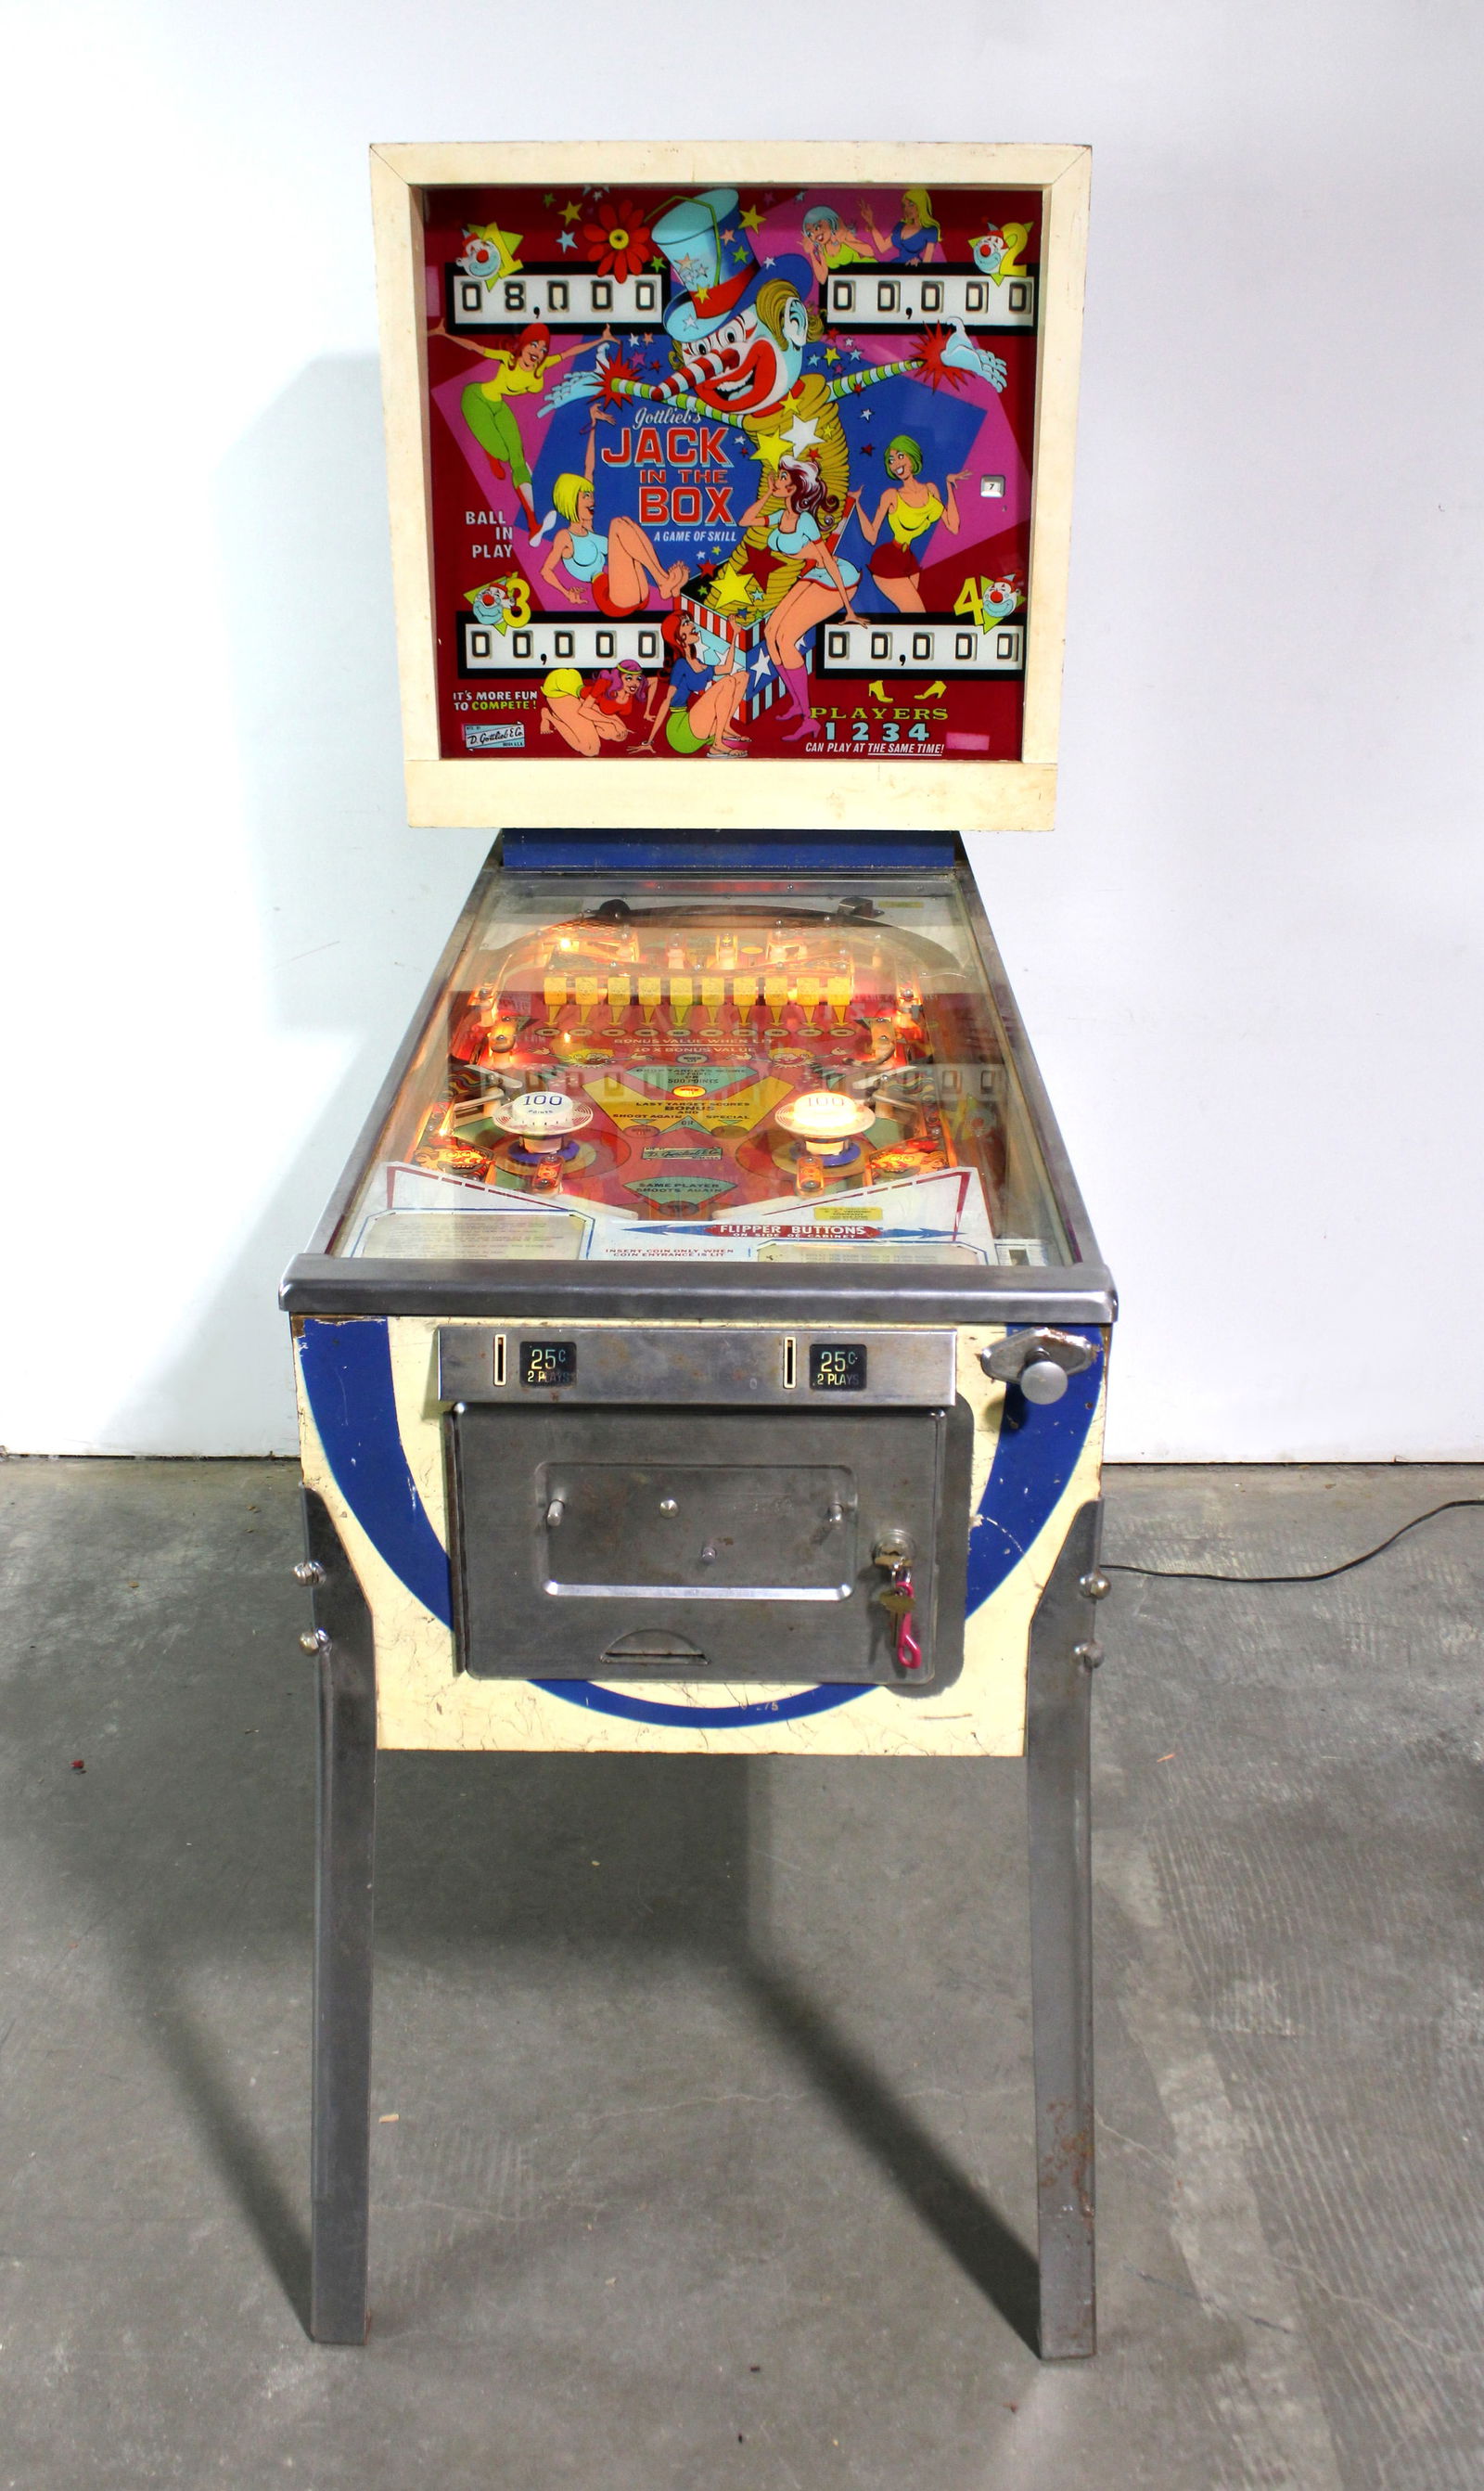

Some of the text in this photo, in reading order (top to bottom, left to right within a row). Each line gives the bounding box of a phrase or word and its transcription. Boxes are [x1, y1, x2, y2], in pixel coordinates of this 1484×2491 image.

[633, 407, 701, 430] Gottlieb's
[601, 427, 734, 468] JACK
[640, 469, 728, 483] IN THE
[638, 486, 737, 527] BOX
[466, 511, 506, 525] BALL
[495, 527, 513, 540] IN
[654, 532, 737, 542] A GAME OF SKILL
[472, 545, 513, 559] PLAY
[502, 578, 531, 628] 3
[953, 576, 986, 626] 4
[453, 690, 537, 700] IT'S MORE FUN
[454, 702, 469, 711] TO
[810, 707, 948, 720] PLAYERS
[825, 722, 929, 742] 1 2 3 4
[806, 742, 944, 753] CAN PLAY AT THE SAME TIME!
[523, 1095, 563, 1106] 100
[720, 1225, 866, 1235] FLIPPER BUTTONS
[528, 1370, 534, 1382] 2
[817, 1373, 860, 1386] 2 PLAYS
